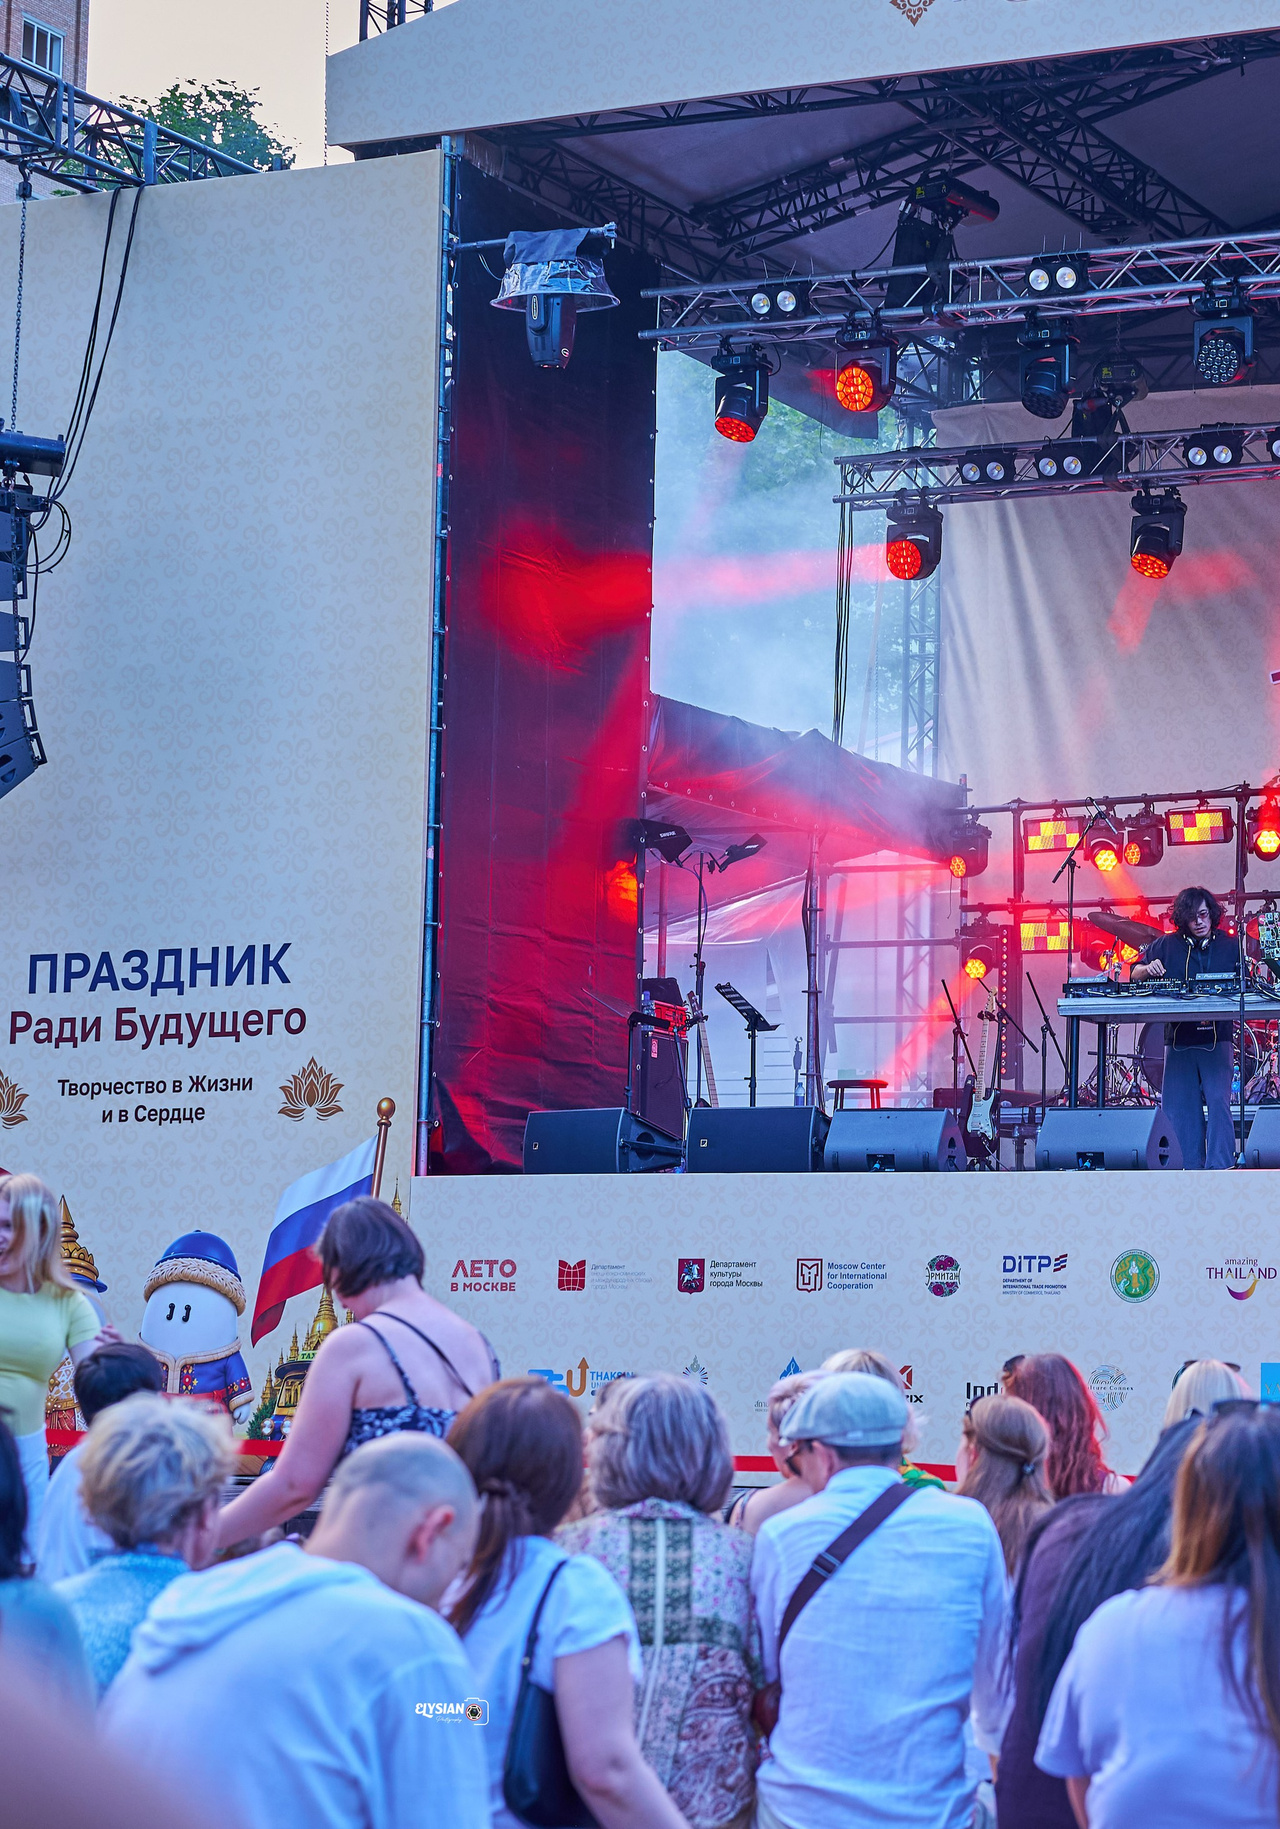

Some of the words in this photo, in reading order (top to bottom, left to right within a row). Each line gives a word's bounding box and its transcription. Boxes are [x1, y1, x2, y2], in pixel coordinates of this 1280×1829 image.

[28, 942, 293, 996] ПРАЗДНИК
[9, 1010, 102, 1048] Ради
[114, 1006, 307, 1050] Будущего
[57, 1076, 167, 1100] Творчество
[172, 1082, 183, 1093] в
[188, 1074, 253, 1093] Жизни
[101, 1109, 113, 1123] и
[118, 1109, 129, 1123] в
[134, 1104, 205, 1126] Сердце
[710, 1260, 757, 1269] Департамент
[827, 1262, 859, 1270] Moscow
[860, 1262, 886, 1270] Center
[1224, 1257, 1258, 1266] amazing
[452, 1259, 517, 1278] ЛЕТО
[710, 1271, 742, 1279] культуры
[827, 1272, 838, 1280] for
[840, 1272, 887, 1280] International
[1206, 1267, 1277, 1280] THAILAND
[450, 1282, 459, 1292] В
[463, 1282, 516, 1292] МОСКВЕ
[710, 1280, 734, 1288] города
[827, 1282, 874, 1290] Cooperation
[301, 1352, 317, 1360] TAX
